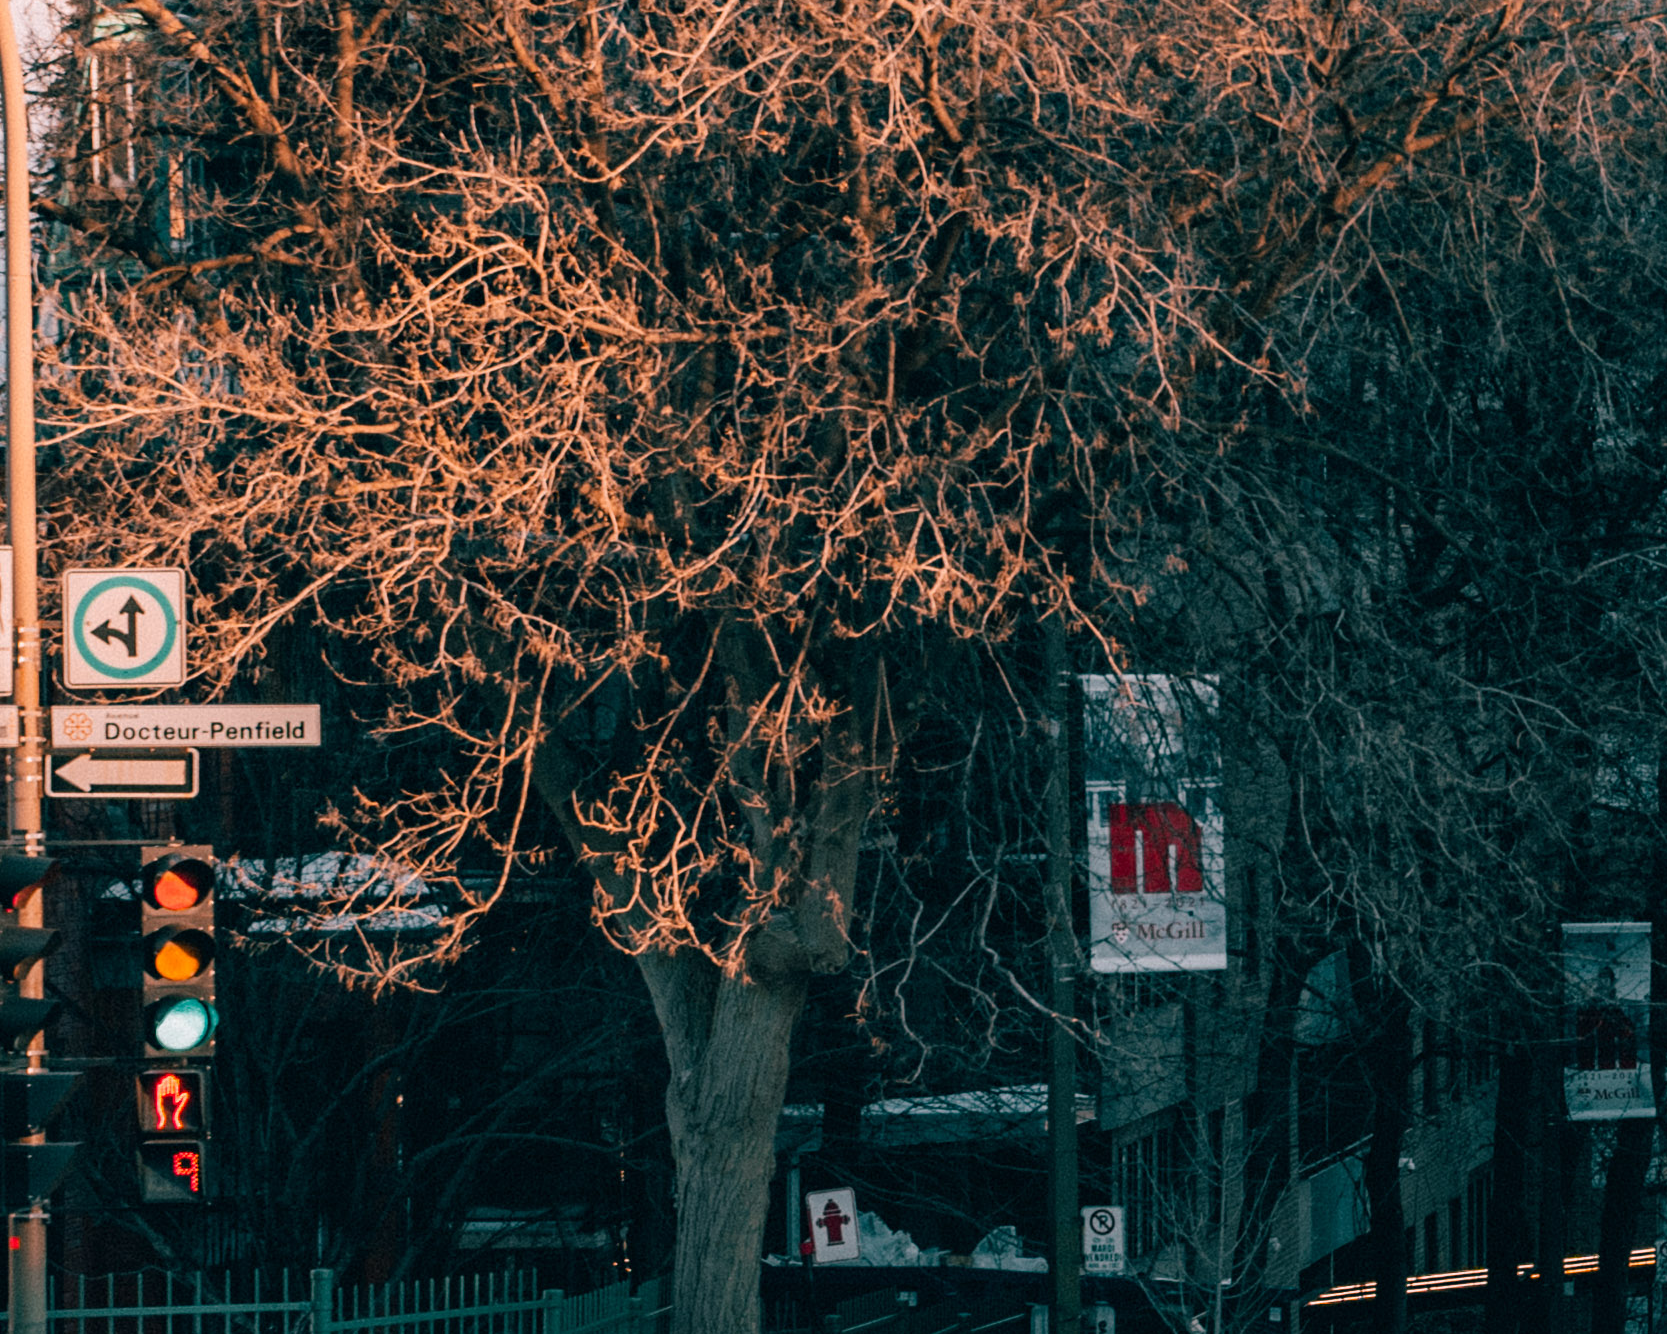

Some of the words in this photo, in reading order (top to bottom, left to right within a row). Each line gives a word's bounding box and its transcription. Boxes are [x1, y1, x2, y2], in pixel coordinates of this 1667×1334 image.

[104, 721, 305, 740] Docteur-Penfield
[1137, 920, 1206, 940] McGill
[1592, 1086, 1641, 1100] McGill
[172, 1151, 199, 1192] 9
